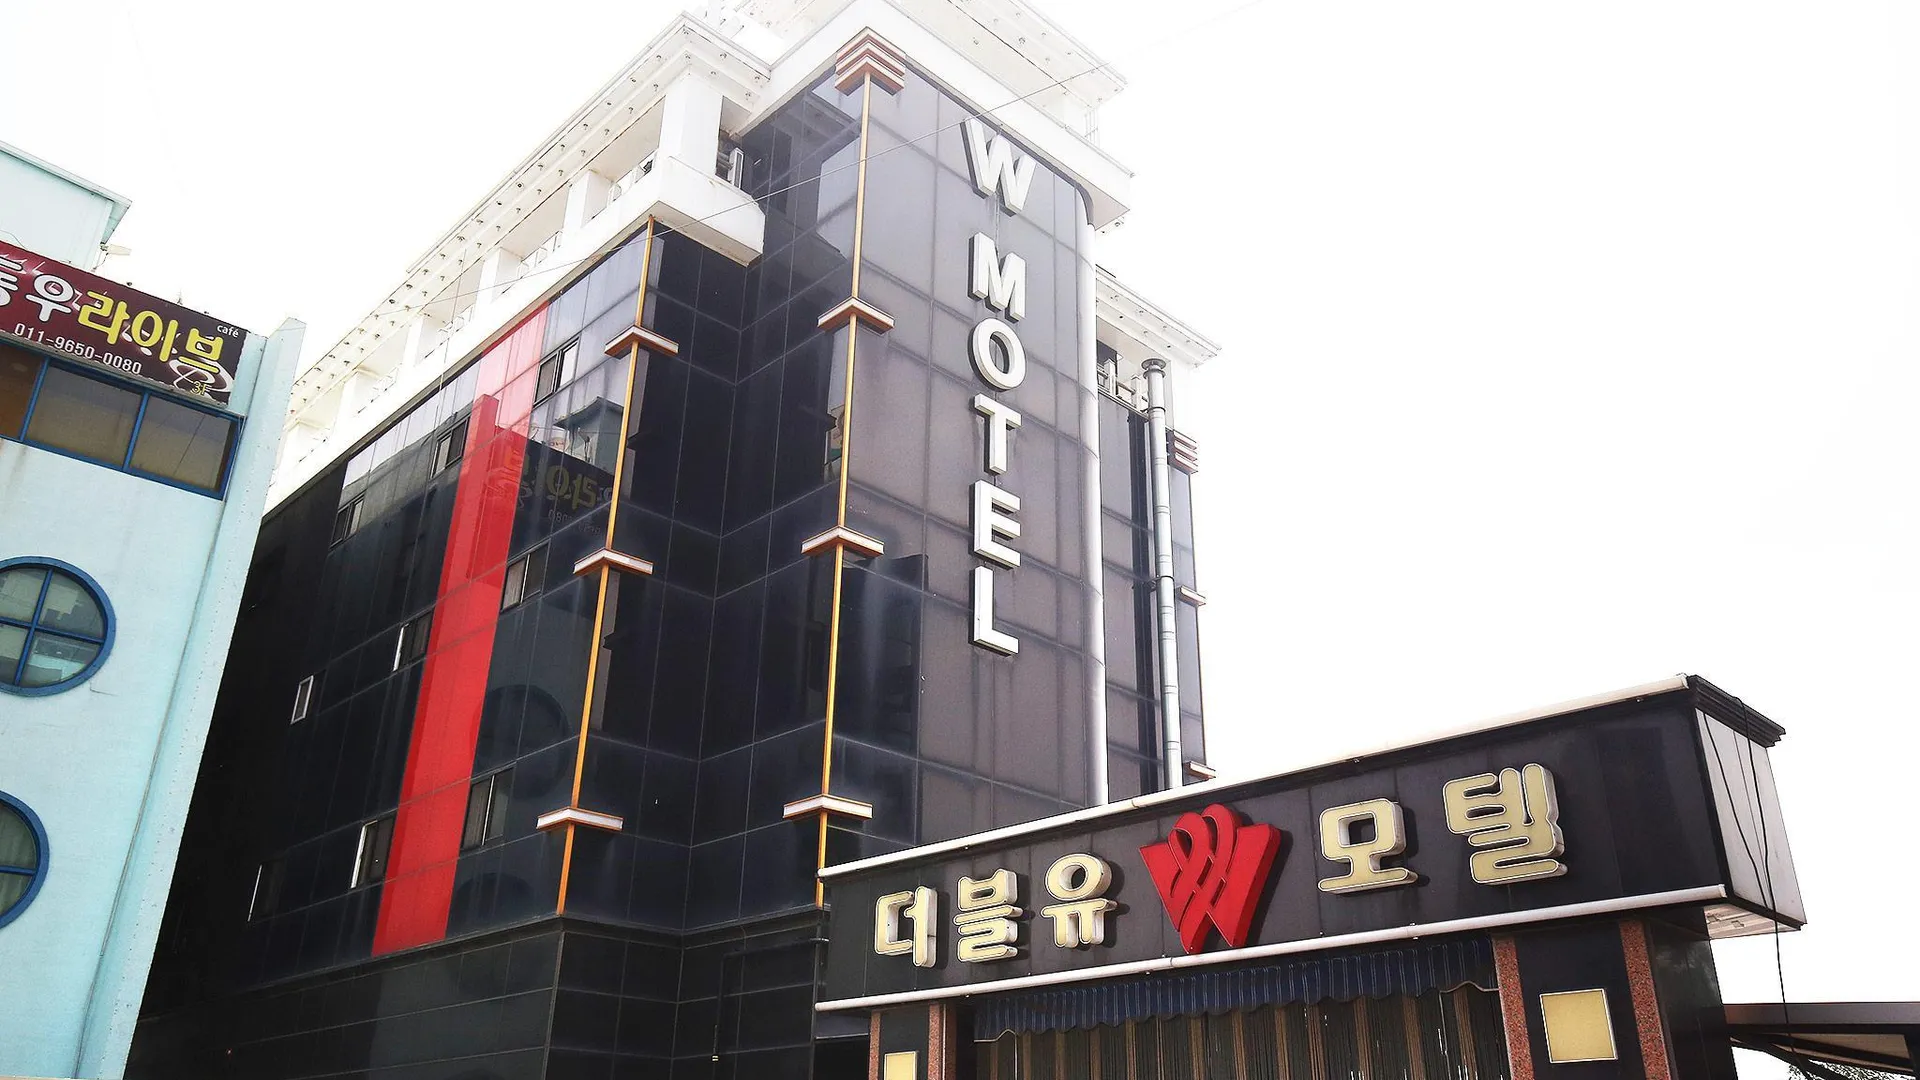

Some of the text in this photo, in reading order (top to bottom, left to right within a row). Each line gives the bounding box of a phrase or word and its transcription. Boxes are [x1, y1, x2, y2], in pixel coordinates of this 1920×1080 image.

[14, 323, 142, 374] 011-9650-0080
[217, 324, 239, 338] café
[960, 116, 1037, 658] W MOTEL
[874, 853, 1118, 968] 더블유
[1318, 763, 1568, 894] 모텔
